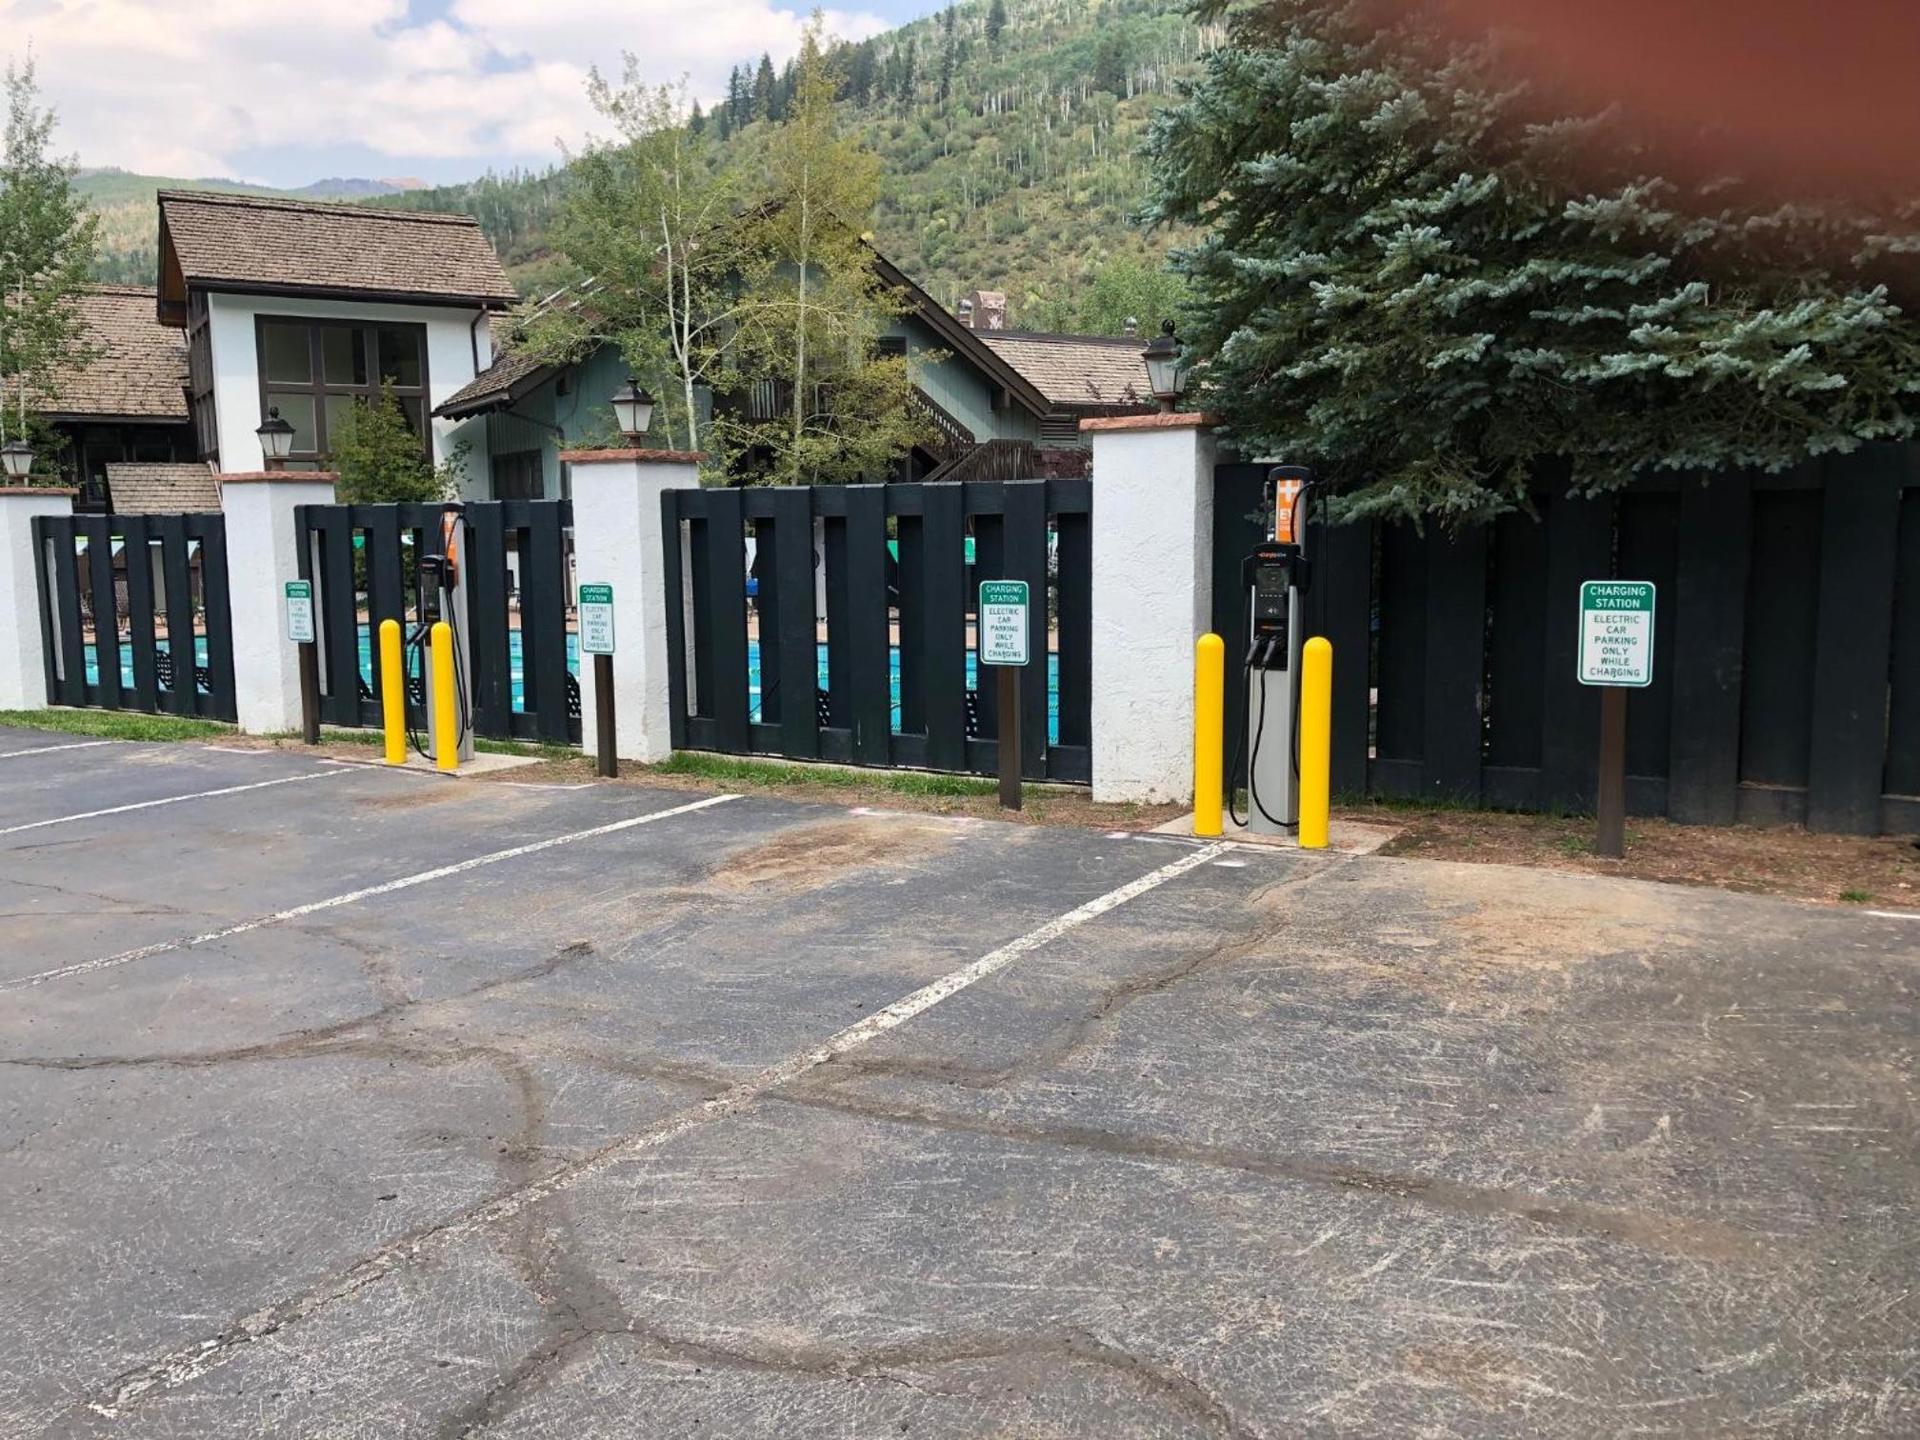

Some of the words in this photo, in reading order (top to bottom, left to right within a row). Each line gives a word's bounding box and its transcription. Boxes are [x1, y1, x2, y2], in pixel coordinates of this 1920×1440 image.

[985, 584, 1023, 593] CHARGING
[1589, 585, 1647, 597] CHARGING
[989, 594, 1020, 603] STATION
[1595, 598, 1640, 608] STATION
[988, 607, 1020, 615] ELECTRIC
[1593, 615, 1641, 624] ELECTRIC
[1606, 625, 1627, 634] CAR
[1593, 635, 1638, 646] PARKING
[1601, 646, 1629, 655] ONLY
[1600, 657, 1630, 667] WHILE
[1589, 667, 1641, 678] CHARGING
